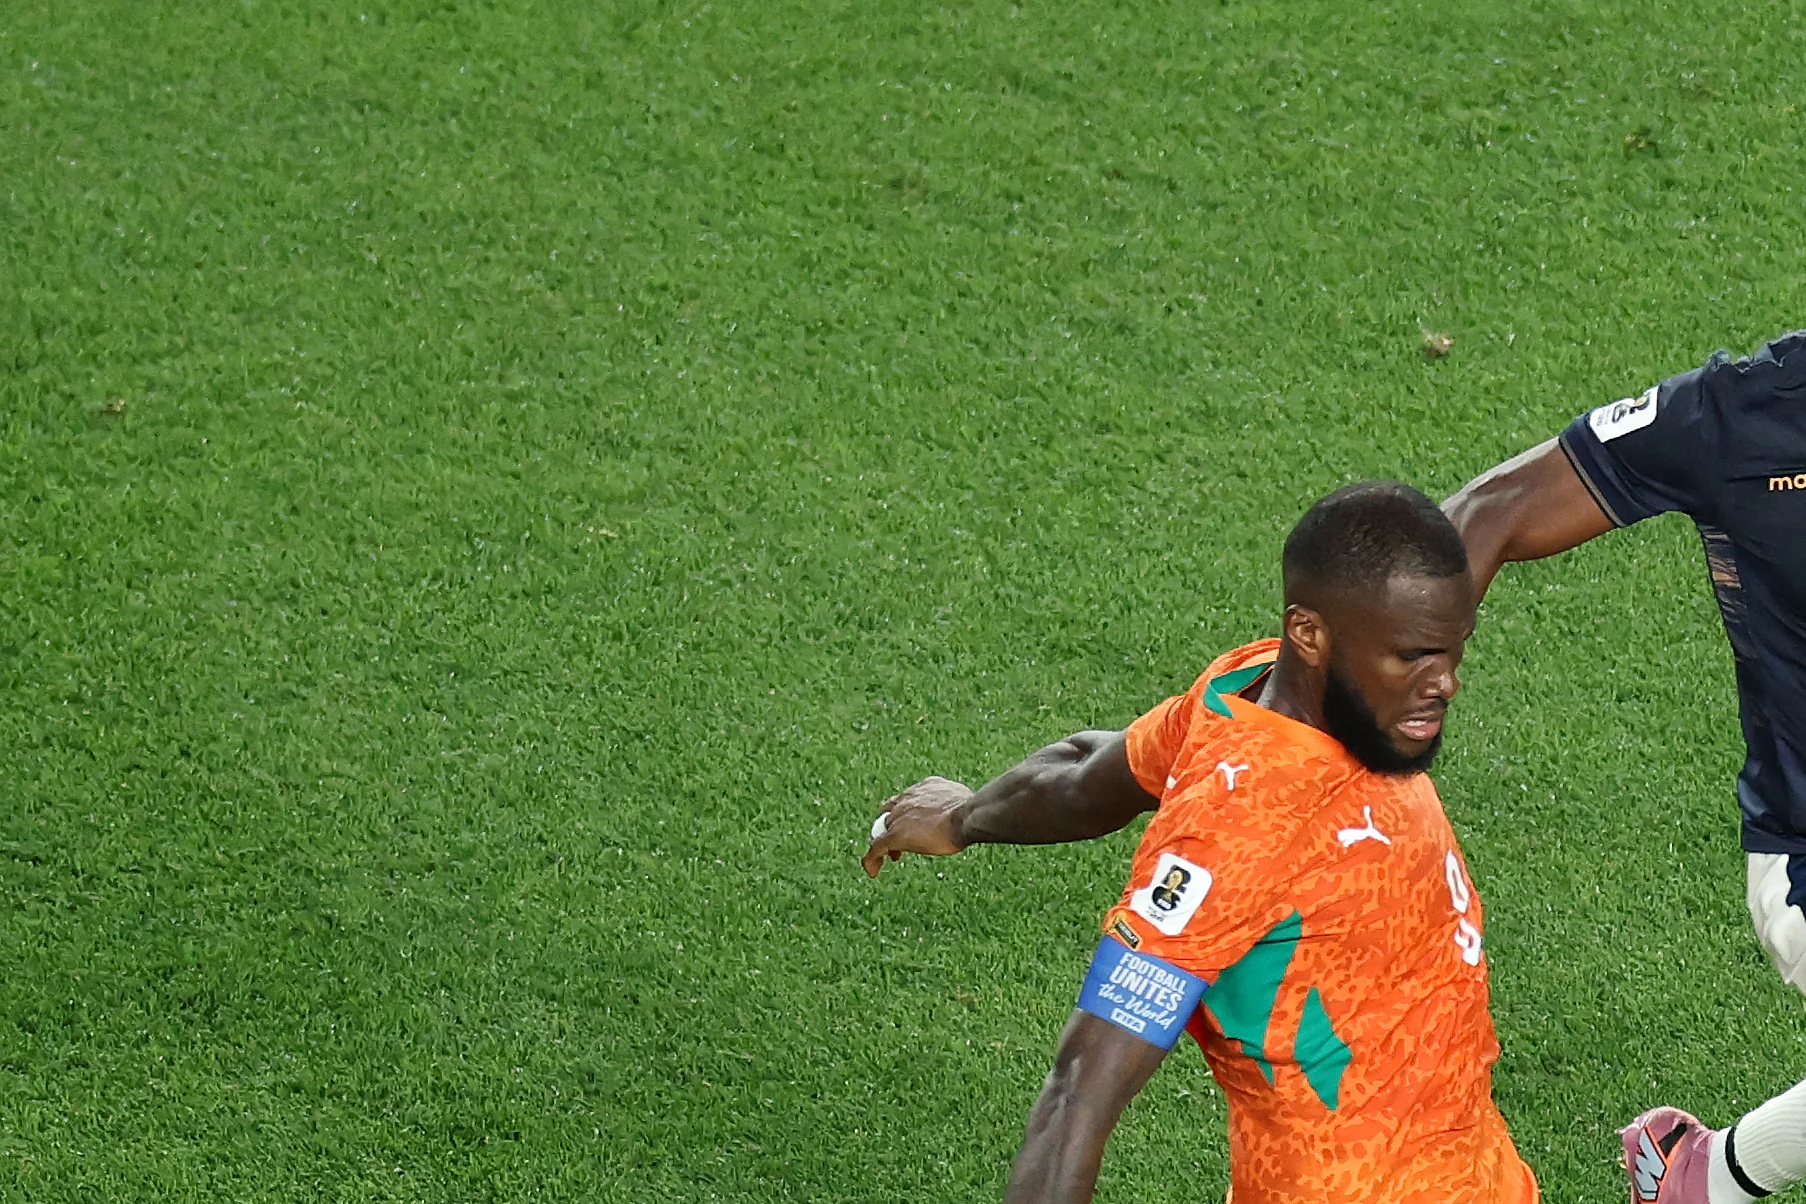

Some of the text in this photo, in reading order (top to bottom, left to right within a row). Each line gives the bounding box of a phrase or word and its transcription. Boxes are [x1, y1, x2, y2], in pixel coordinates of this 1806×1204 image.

[1109, 965, 1183, 1011] UNITES
[1120, 952, 1187, 995] FOOTBALL
[1098, 984, 1177, 1030] the World
